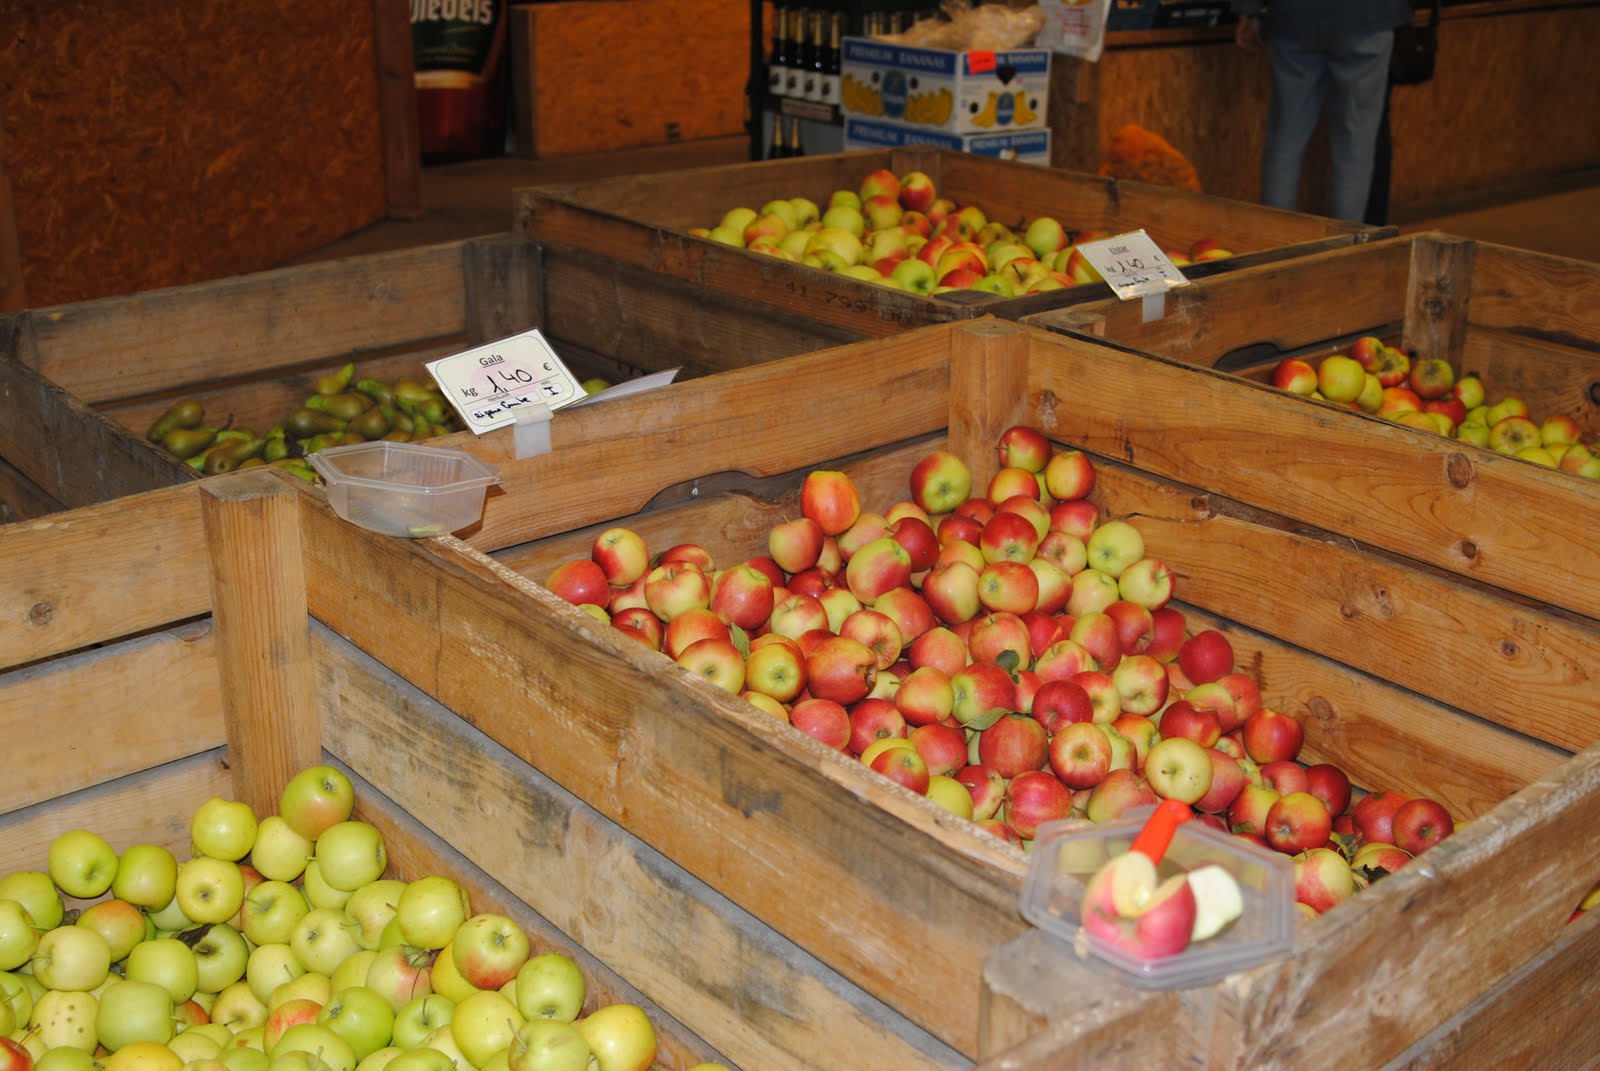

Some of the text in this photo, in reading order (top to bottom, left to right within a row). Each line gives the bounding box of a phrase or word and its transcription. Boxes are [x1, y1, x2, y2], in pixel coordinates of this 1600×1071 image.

[479, 353, 504, 366] Gala
[461, 362, 552, 397] kg 1,40 €
